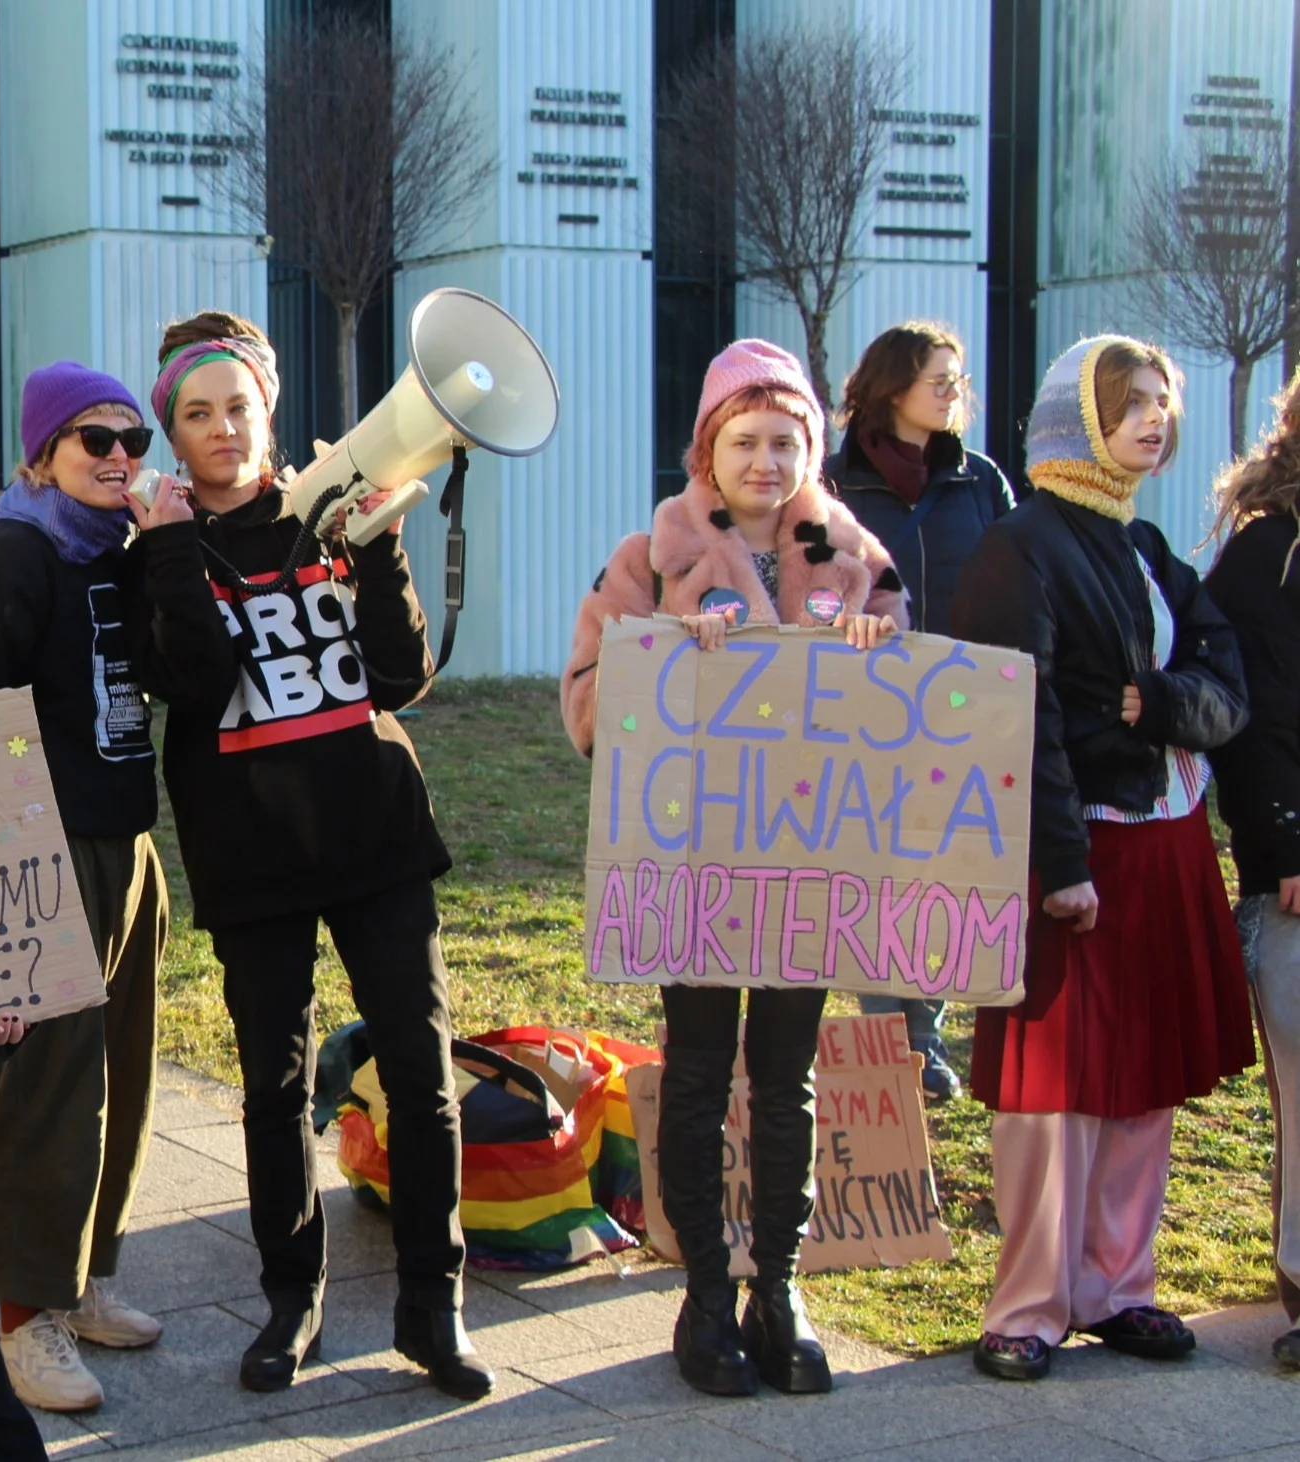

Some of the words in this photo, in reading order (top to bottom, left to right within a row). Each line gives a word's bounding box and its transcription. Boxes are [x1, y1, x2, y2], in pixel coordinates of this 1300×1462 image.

[110, 708, 127, 720] 200
[218, 639, 369, 730] ABO
[642, 743, 1005, 860] CHWAŁA
[591, 857, 1022, 995] ABORTERKOM
[852, 1016, 909, 1067] NIE
